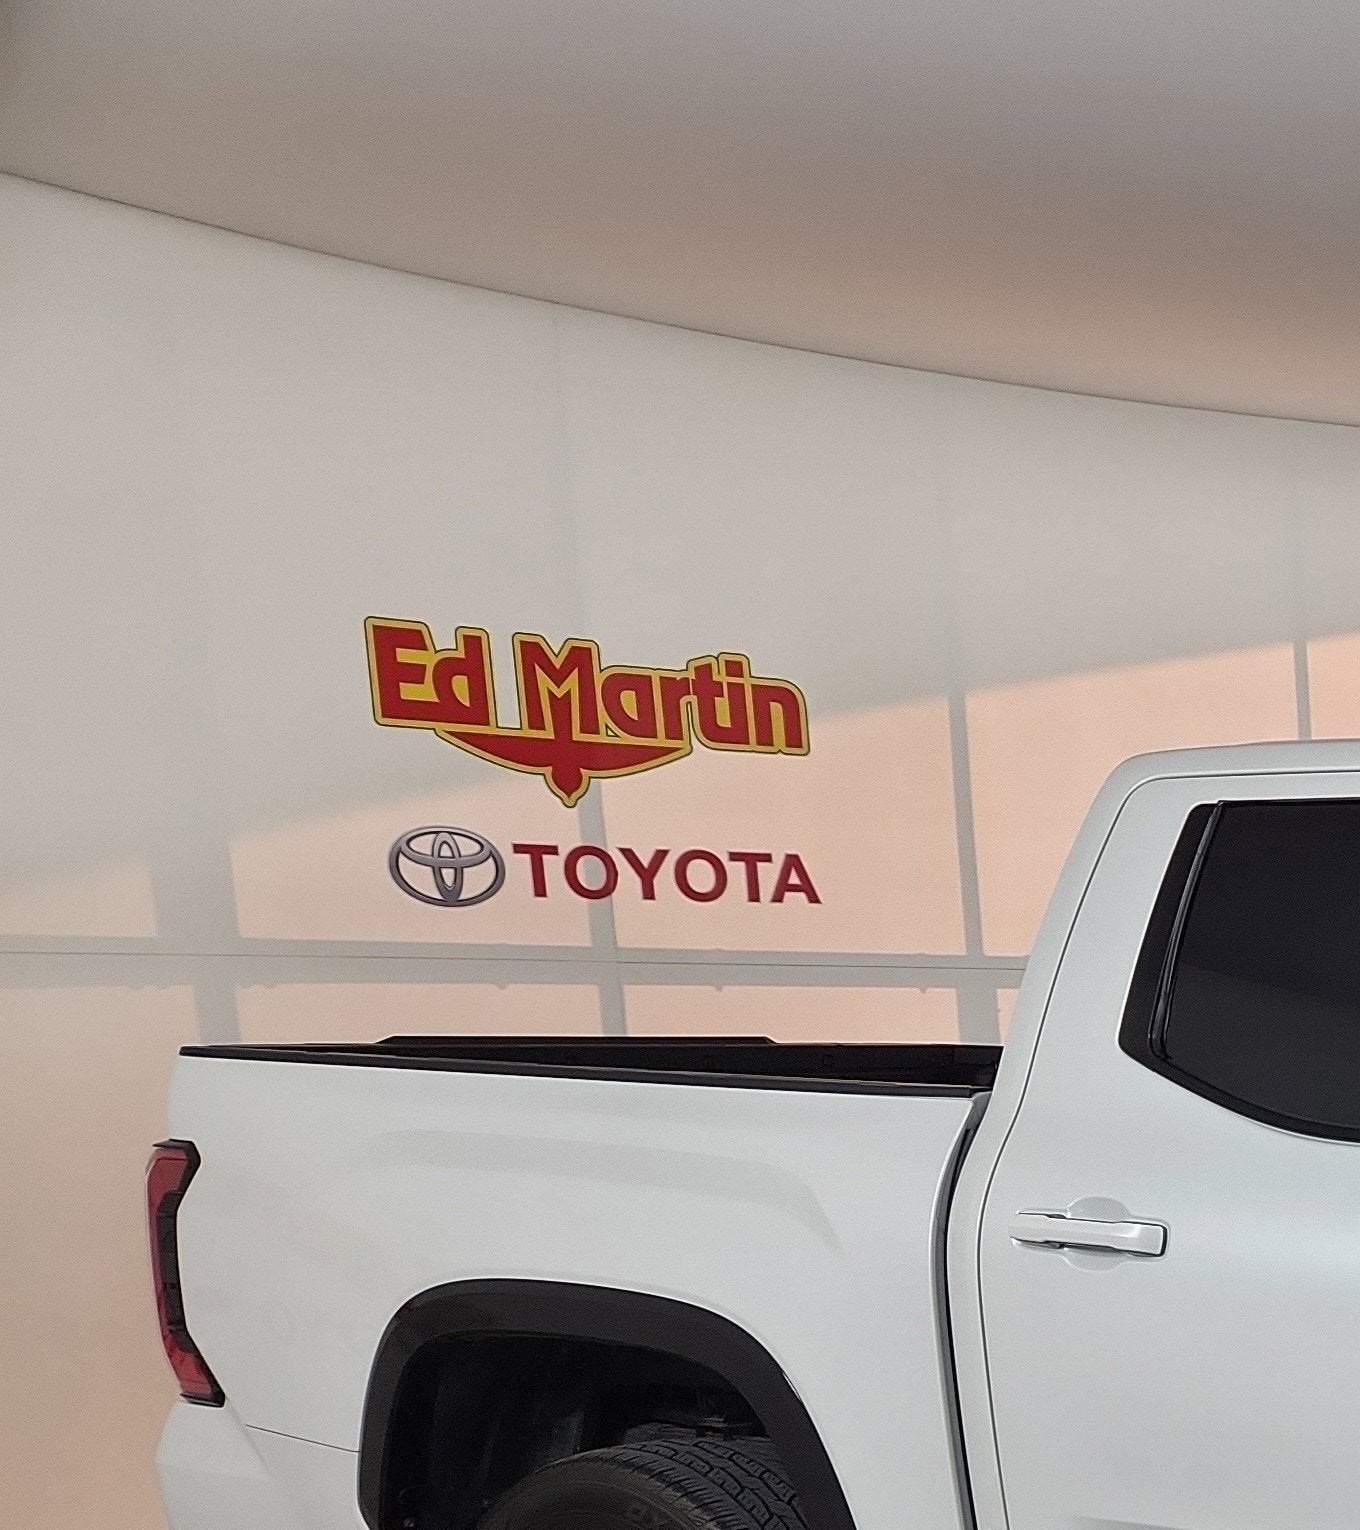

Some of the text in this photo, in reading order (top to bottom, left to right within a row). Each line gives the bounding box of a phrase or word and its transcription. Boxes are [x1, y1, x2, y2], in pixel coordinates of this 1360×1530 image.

[368, 620, 807, 751] Ed Martin
[513, 843, 823, 905] TOYOTA
